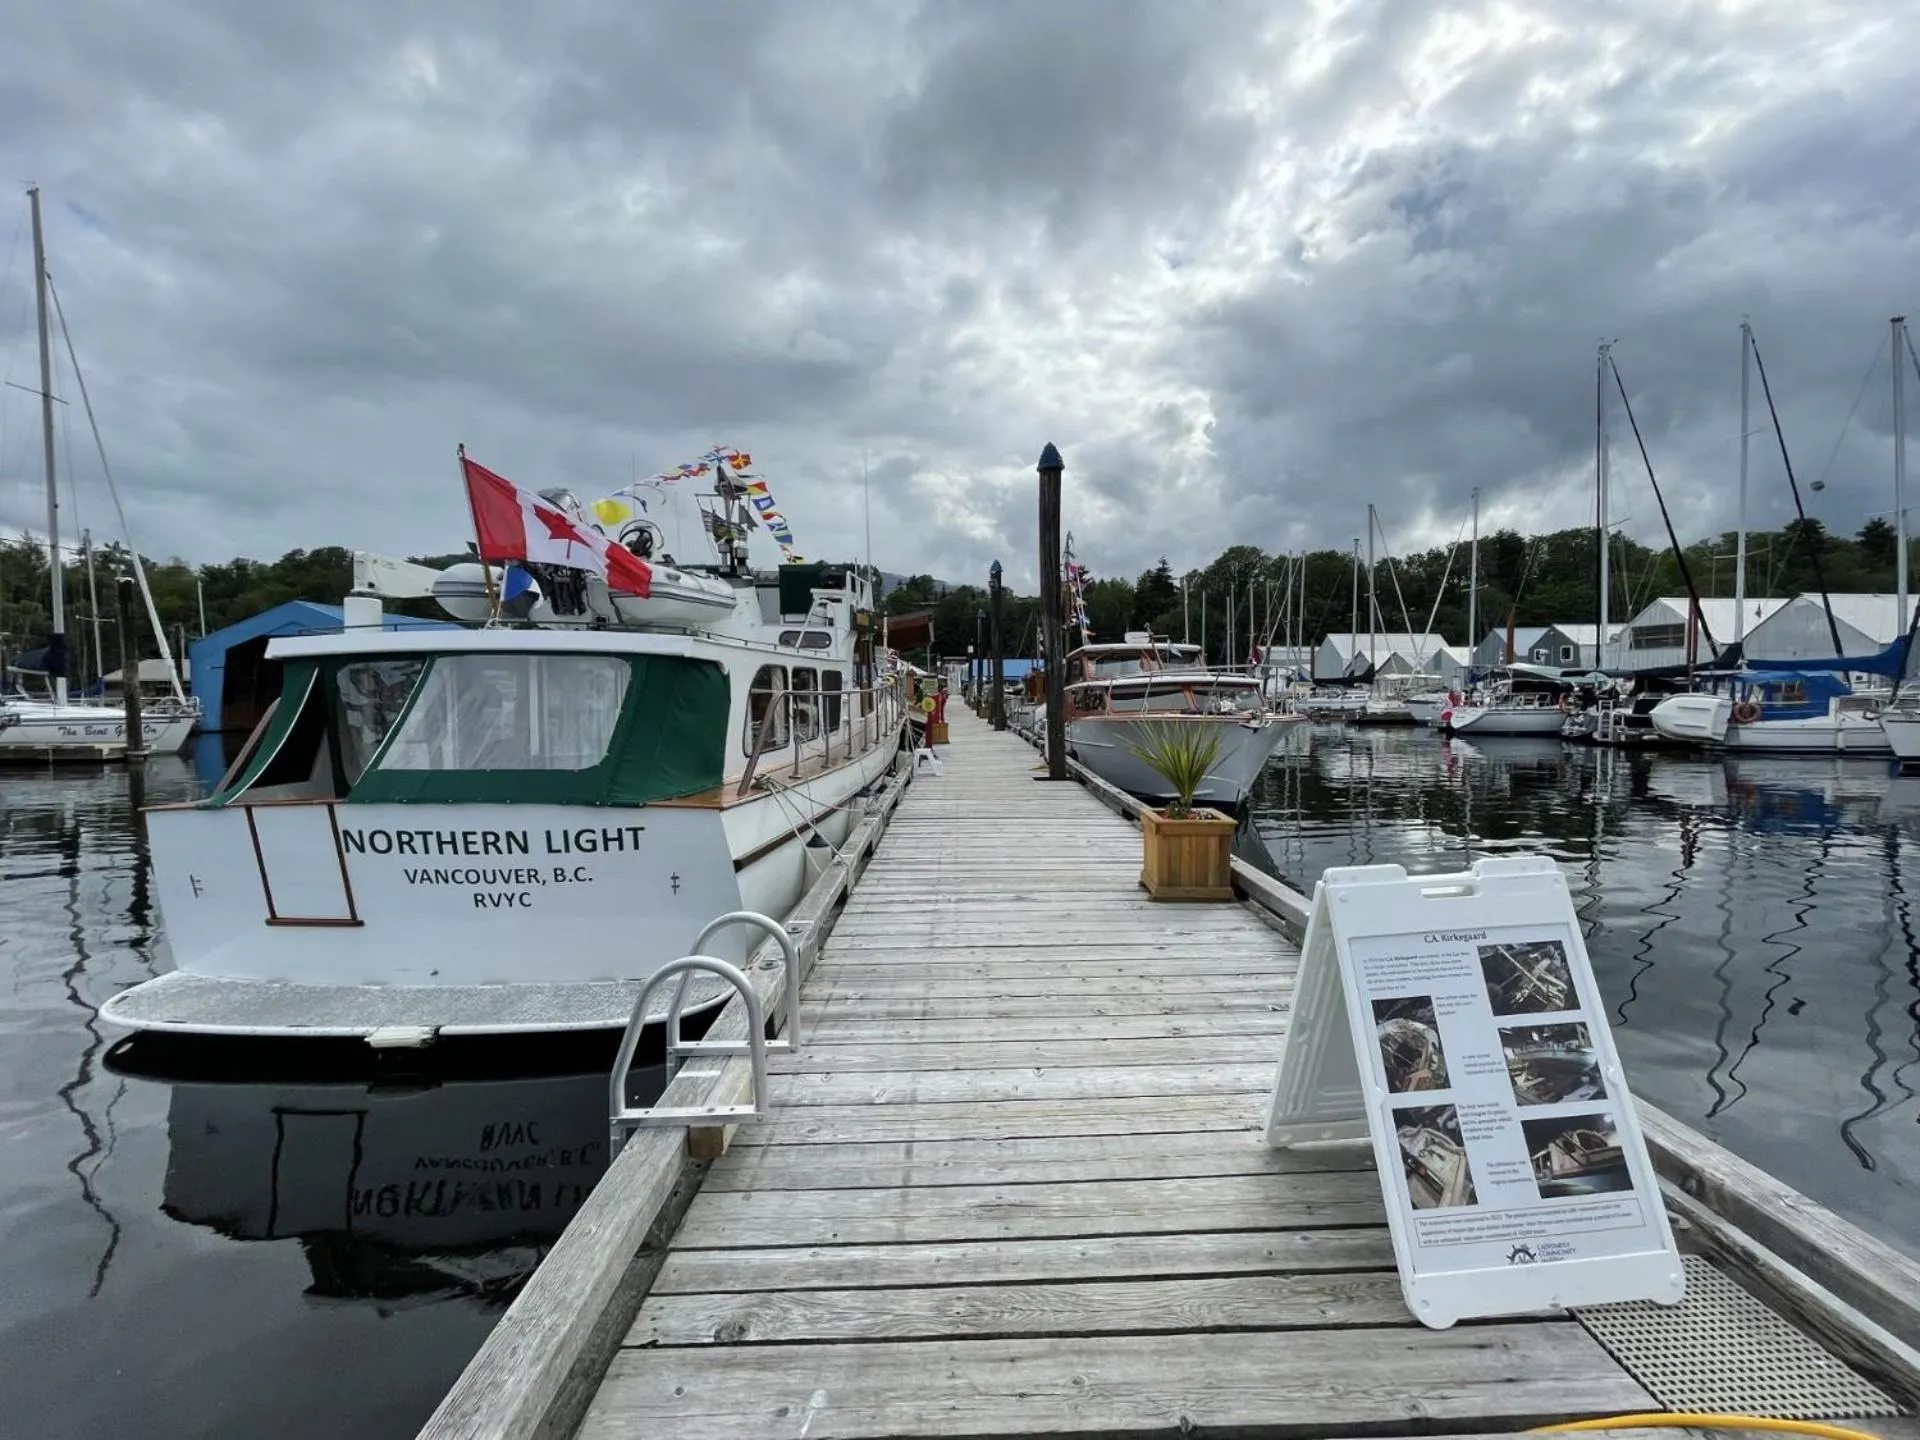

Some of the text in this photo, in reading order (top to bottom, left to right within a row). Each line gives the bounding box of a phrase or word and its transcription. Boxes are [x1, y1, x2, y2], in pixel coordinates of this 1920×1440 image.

[58, 726, 77, 736] The
[144, 724, 157, 734] On
[342, 826, 645, 856] NORTHERN LIGHT
[404, 866, 593, 886] VANCOUVER, B.C.
[473, 892, 532, 909] RVYC
